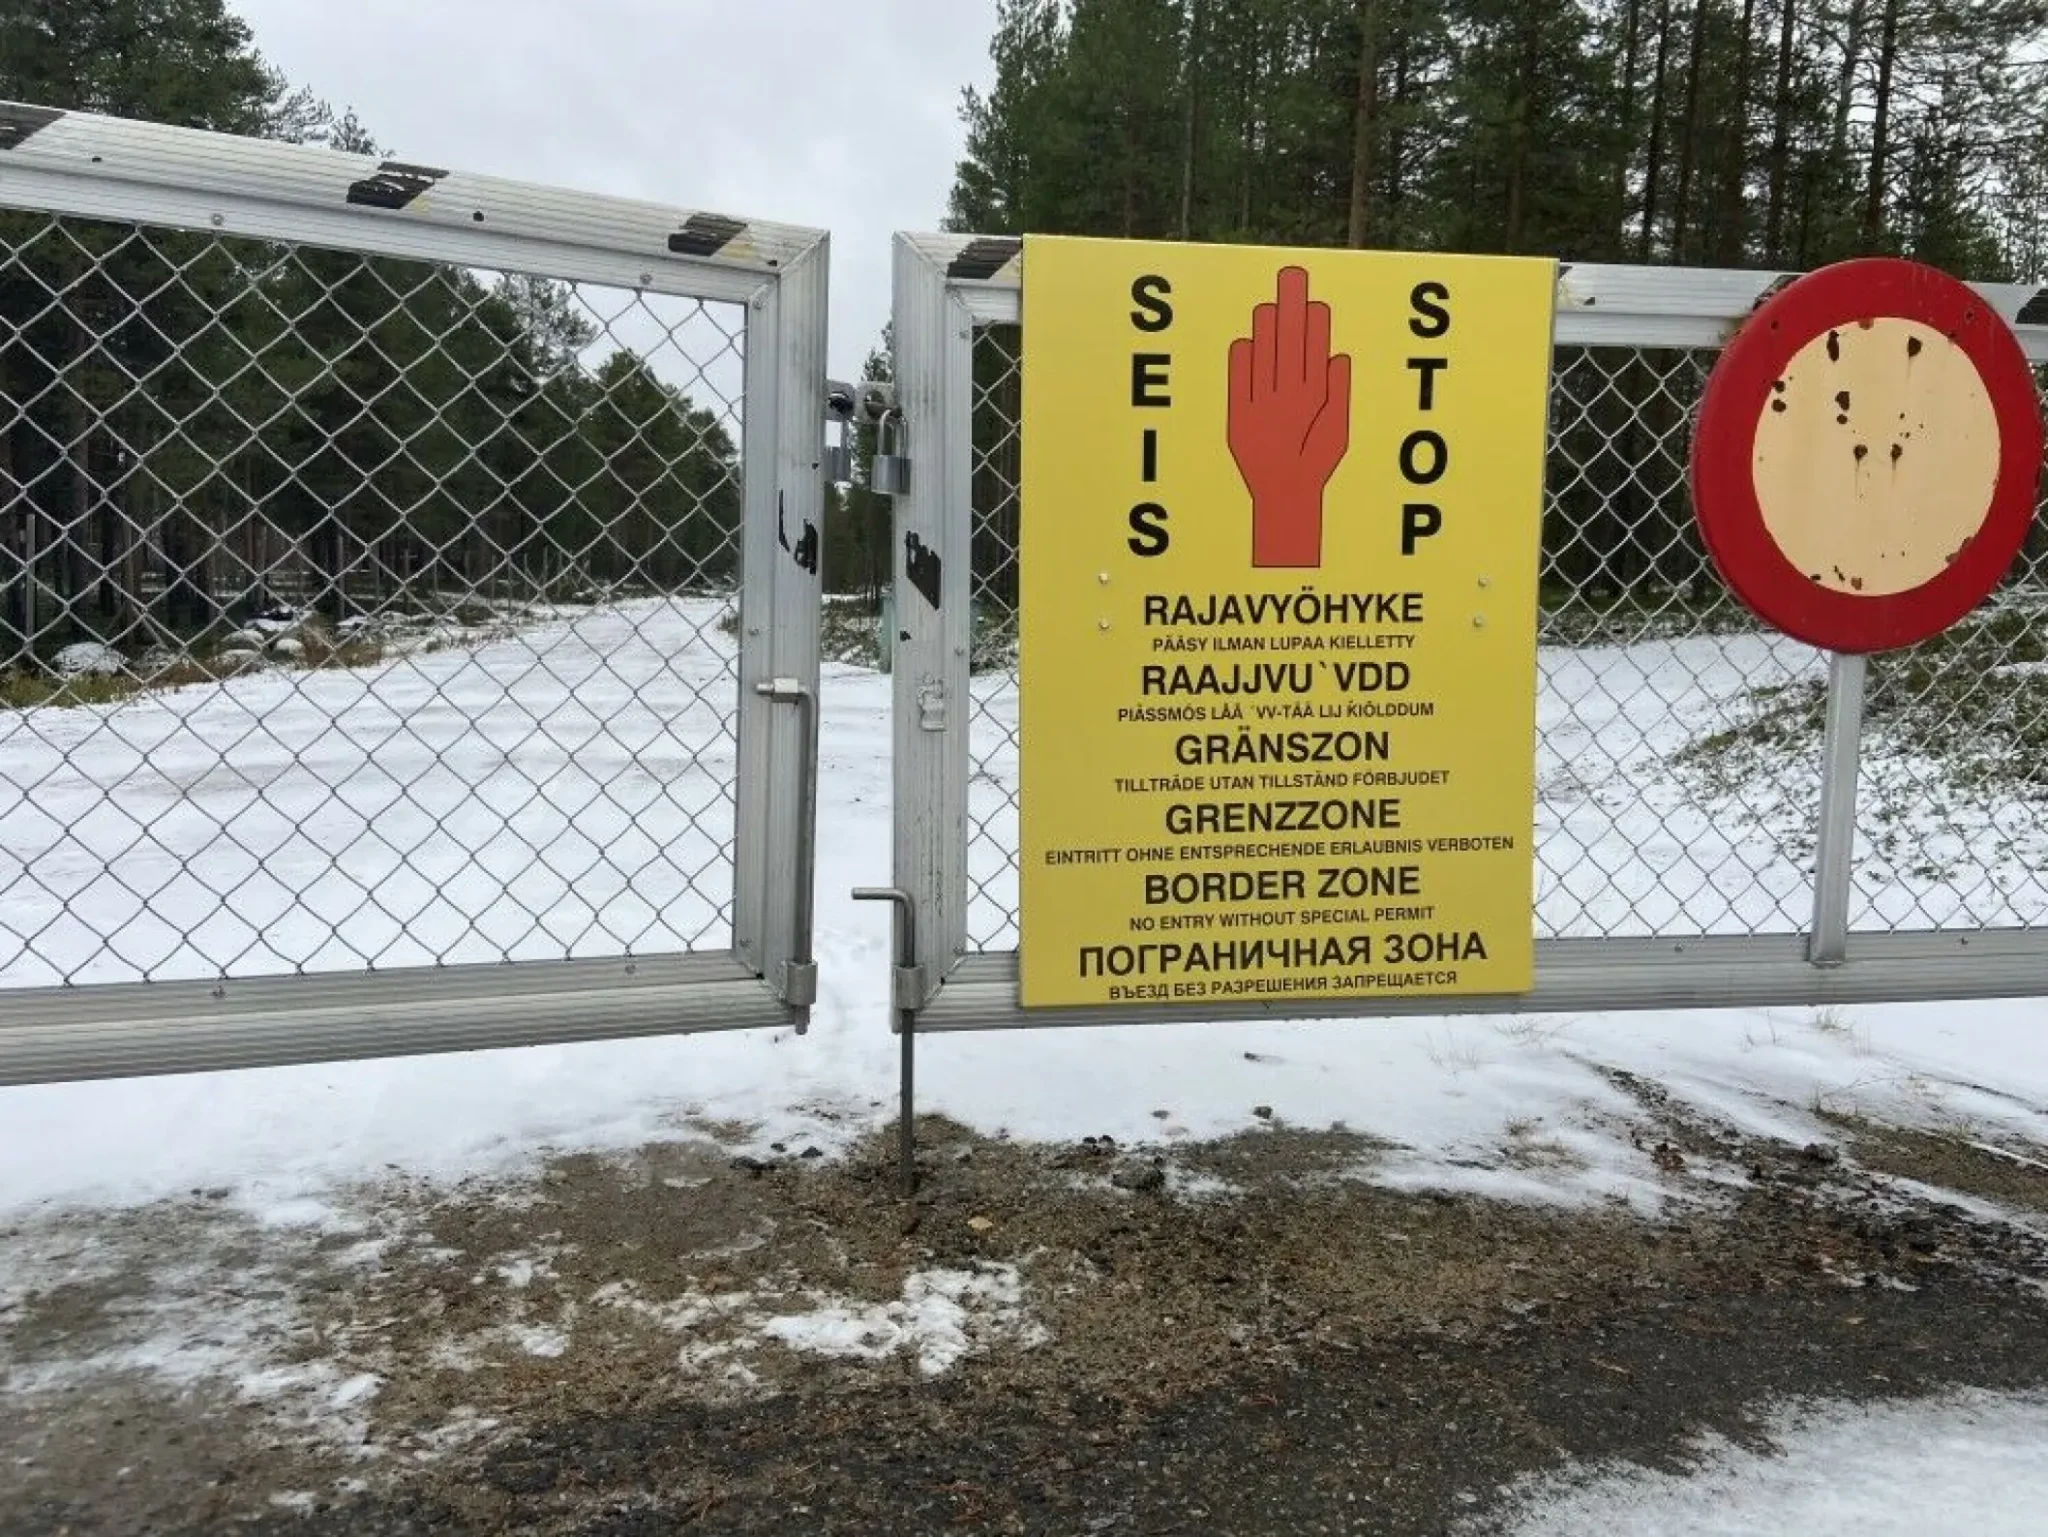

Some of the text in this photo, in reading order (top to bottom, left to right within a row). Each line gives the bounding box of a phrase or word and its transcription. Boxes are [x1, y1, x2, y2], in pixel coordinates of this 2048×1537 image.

[1127, 275, 1173, 557] SEIS
[1399, 282, 1450, 556] STOP
[1143, 585, 1424, 626] RAJAVYÖHYKE
[1153, 635, 1415, 653] PÄÄSY ILMAN LUPAA KIELLETTY
[1320, 702, 1342, 718] LIJ
[1175, 725, 1391, 764] GRÄNSZON
[1115, 769, 1451, 791] TILLTRÄDE UTAN TILLSTÅND FÖRBJUDET
[1165, 798, 1402, 835] GRENZZONE
[1045, 836, 1514, 865] EINTRITT OHNE ENTSPRECHENDE ERLAUBNIS VERBOTEN
[1145, 866, 1421, 905] BORDER ZONE
[1129, 906, 1434, 931] NO ENTRY WITHOUT SPECIAL PERMIT
[1079, 931, 1488, 978] ПОГРАНИЧНАЯ ЗОНА
[1109, 971, 1457, 1001] ВЪЕЗД БЕЗ РАЗРЕШЕНИЯ ЗАПРЕЩАЕТСЯ
